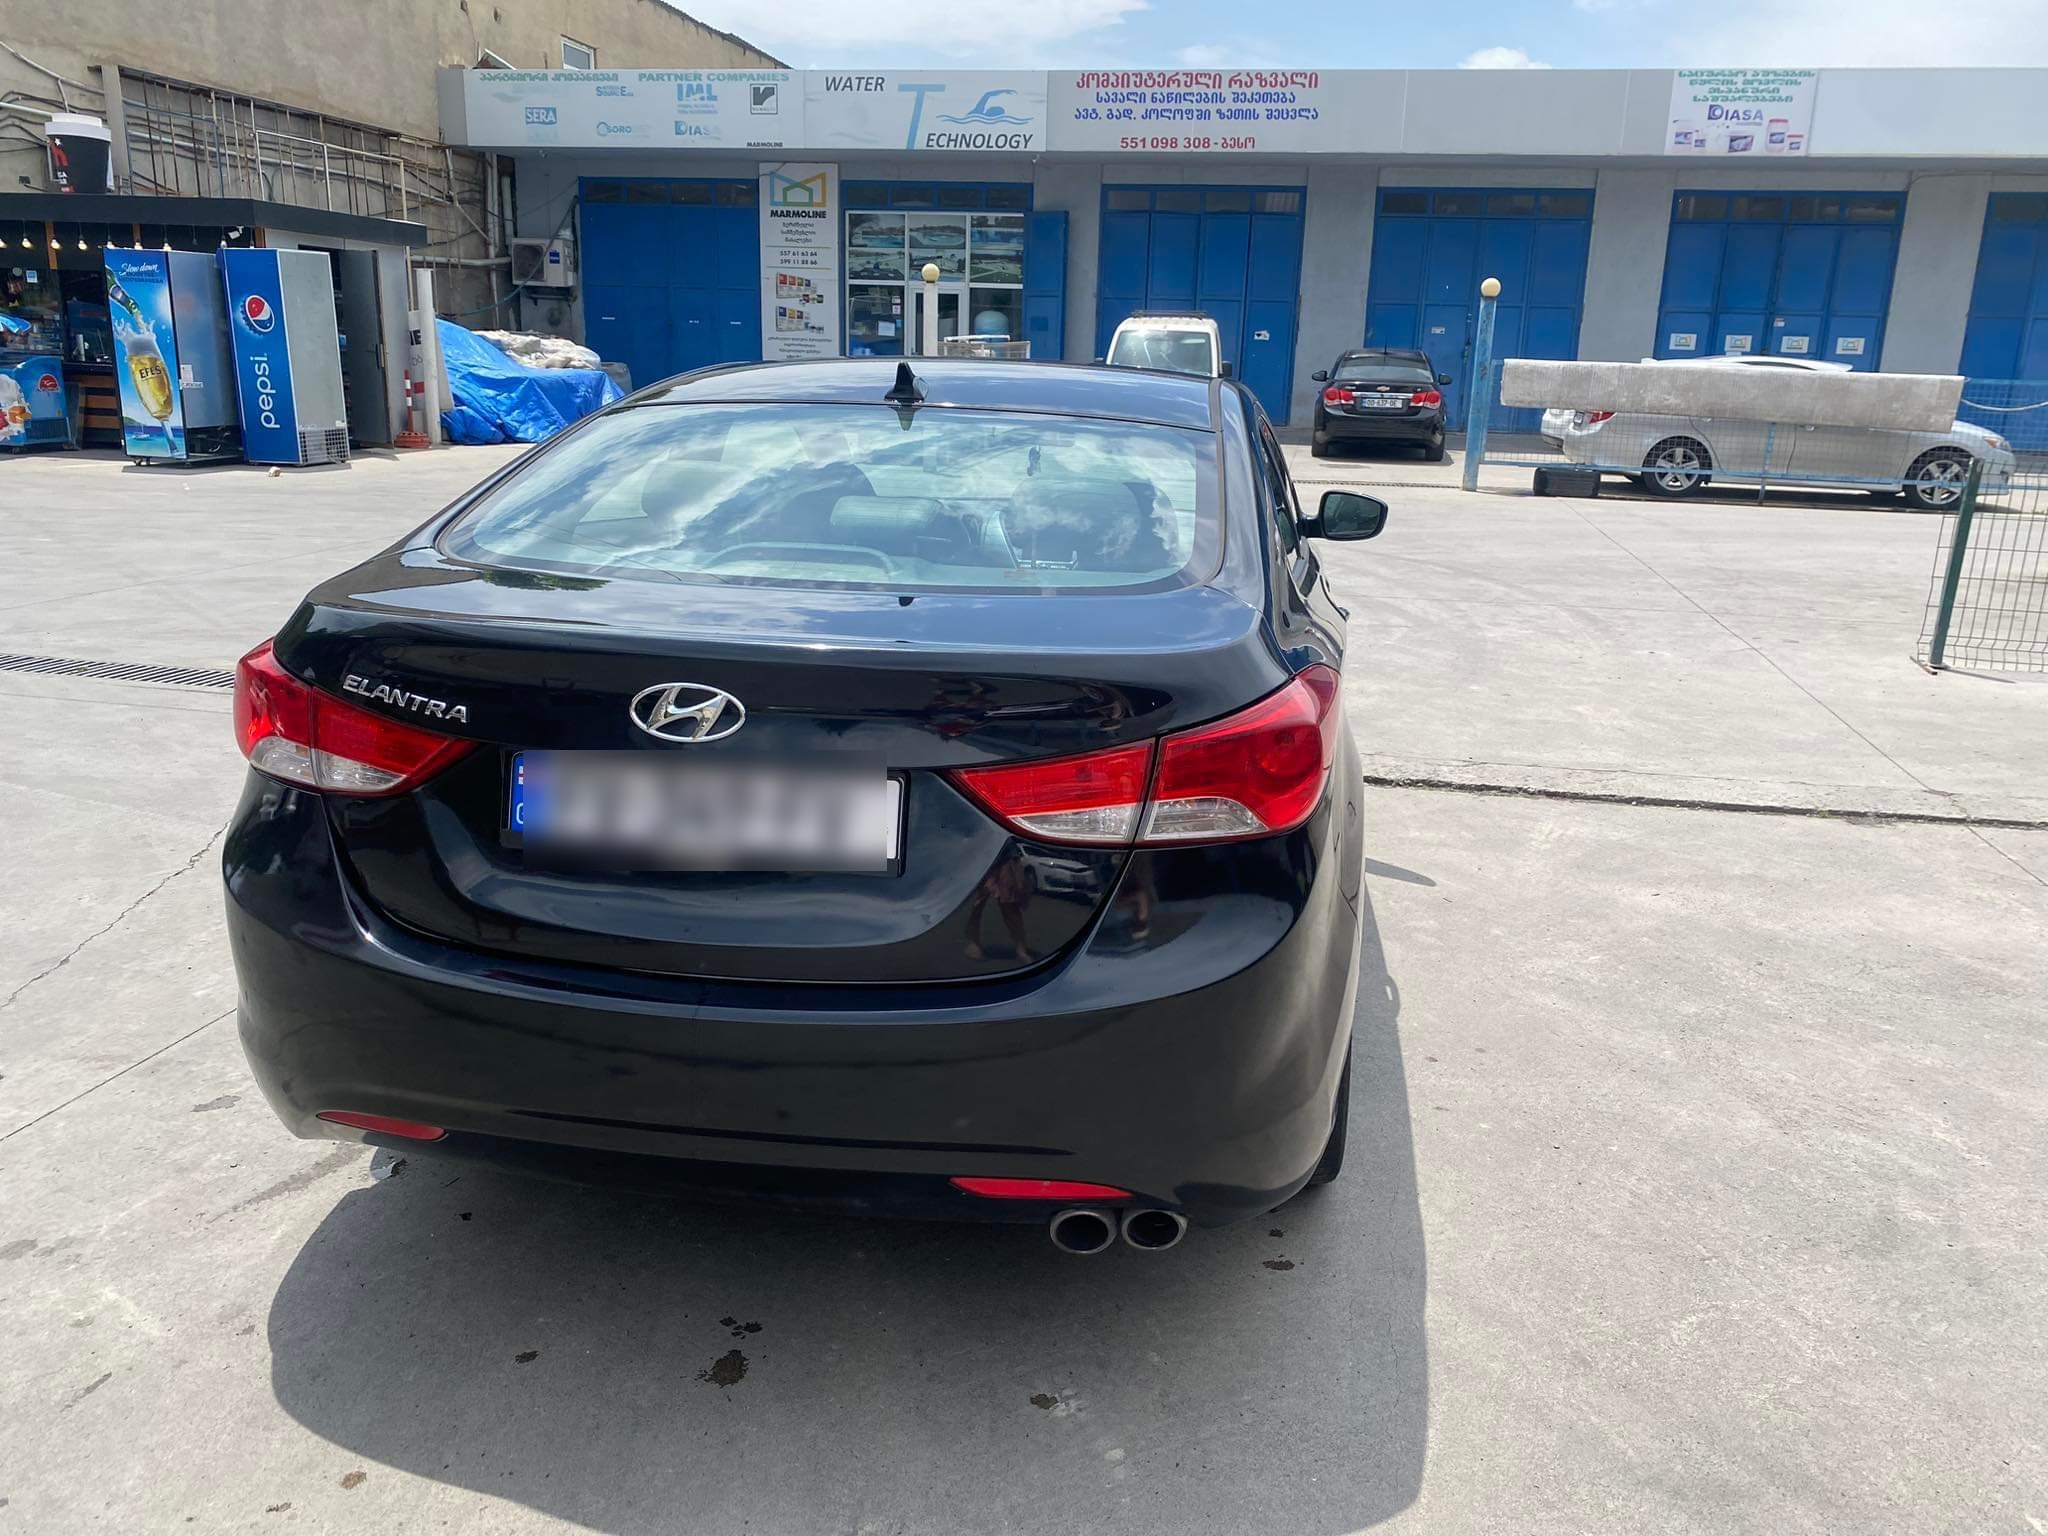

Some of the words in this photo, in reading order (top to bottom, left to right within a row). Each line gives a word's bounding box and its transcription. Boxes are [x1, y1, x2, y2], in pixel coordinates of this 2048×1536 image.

[638, 73, 703, 82] PARTNER
[706, 73, 790, 82] COMPANIES
[825, 76, 885, 92] WATER
[1076, 72, 1222, 88] კომპიუტერული
[1228, 72, 1319, 88] რაზვალი
[1096, 92, 1146, 104] სავალი
[1151, 92, 1226, 104] ნაწილების
[1232, 92, 1296, 104] შეკეთება
[526, 109, 556, 123] SERA
[1141, 108, 1211, 120] კოლოფში
[1216, 108, 1259, 120] ზეთის
[1265, 108, 1319, 120] შეცვლა
[1708, 104, 1763, 121] DIASA
[1120, 137, 1147, 149] 551
[1151, 137, 1178, 149] 098
[1183, 137, 1211, 149] 308
[1221, 137, 1256, 149] ბესო
[770, 210, 827, 218] MARMOLINE
[139, 366, 162, 379] EFES
[250, 354, 280, 429] pepsi
[342, 674, 468, 723] ELANTRA
